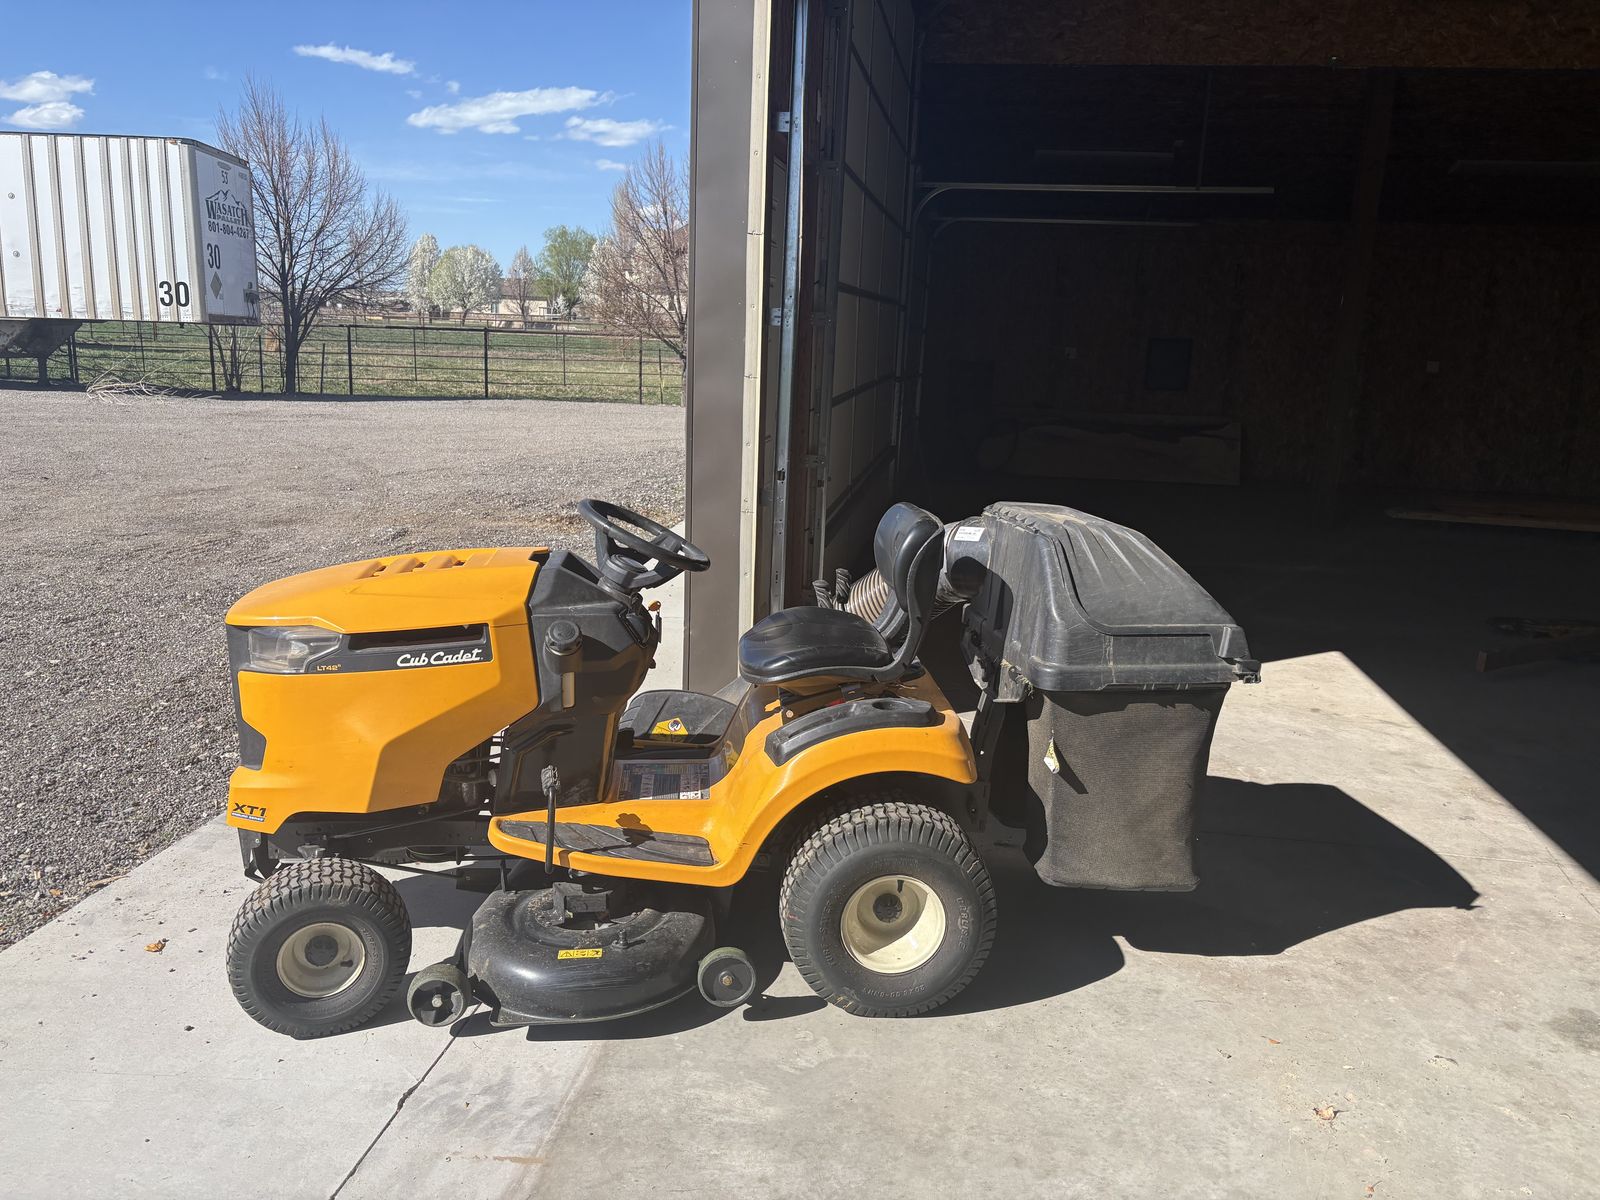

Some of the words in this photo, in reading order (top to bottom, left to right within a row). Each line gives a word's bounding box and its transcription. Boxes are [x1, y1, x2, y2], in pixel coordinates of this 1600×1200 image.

[221, 170, 229, 185] 53
[205, 199, 249, 227] WASATCH
[207, 243, 221, 270] 30
[159, 281, 190, 307] 30
[396, 652, 429, 668] Cub
[429, 647, 483, 665] Cadet
[232, 802, 267, 817] XT1
